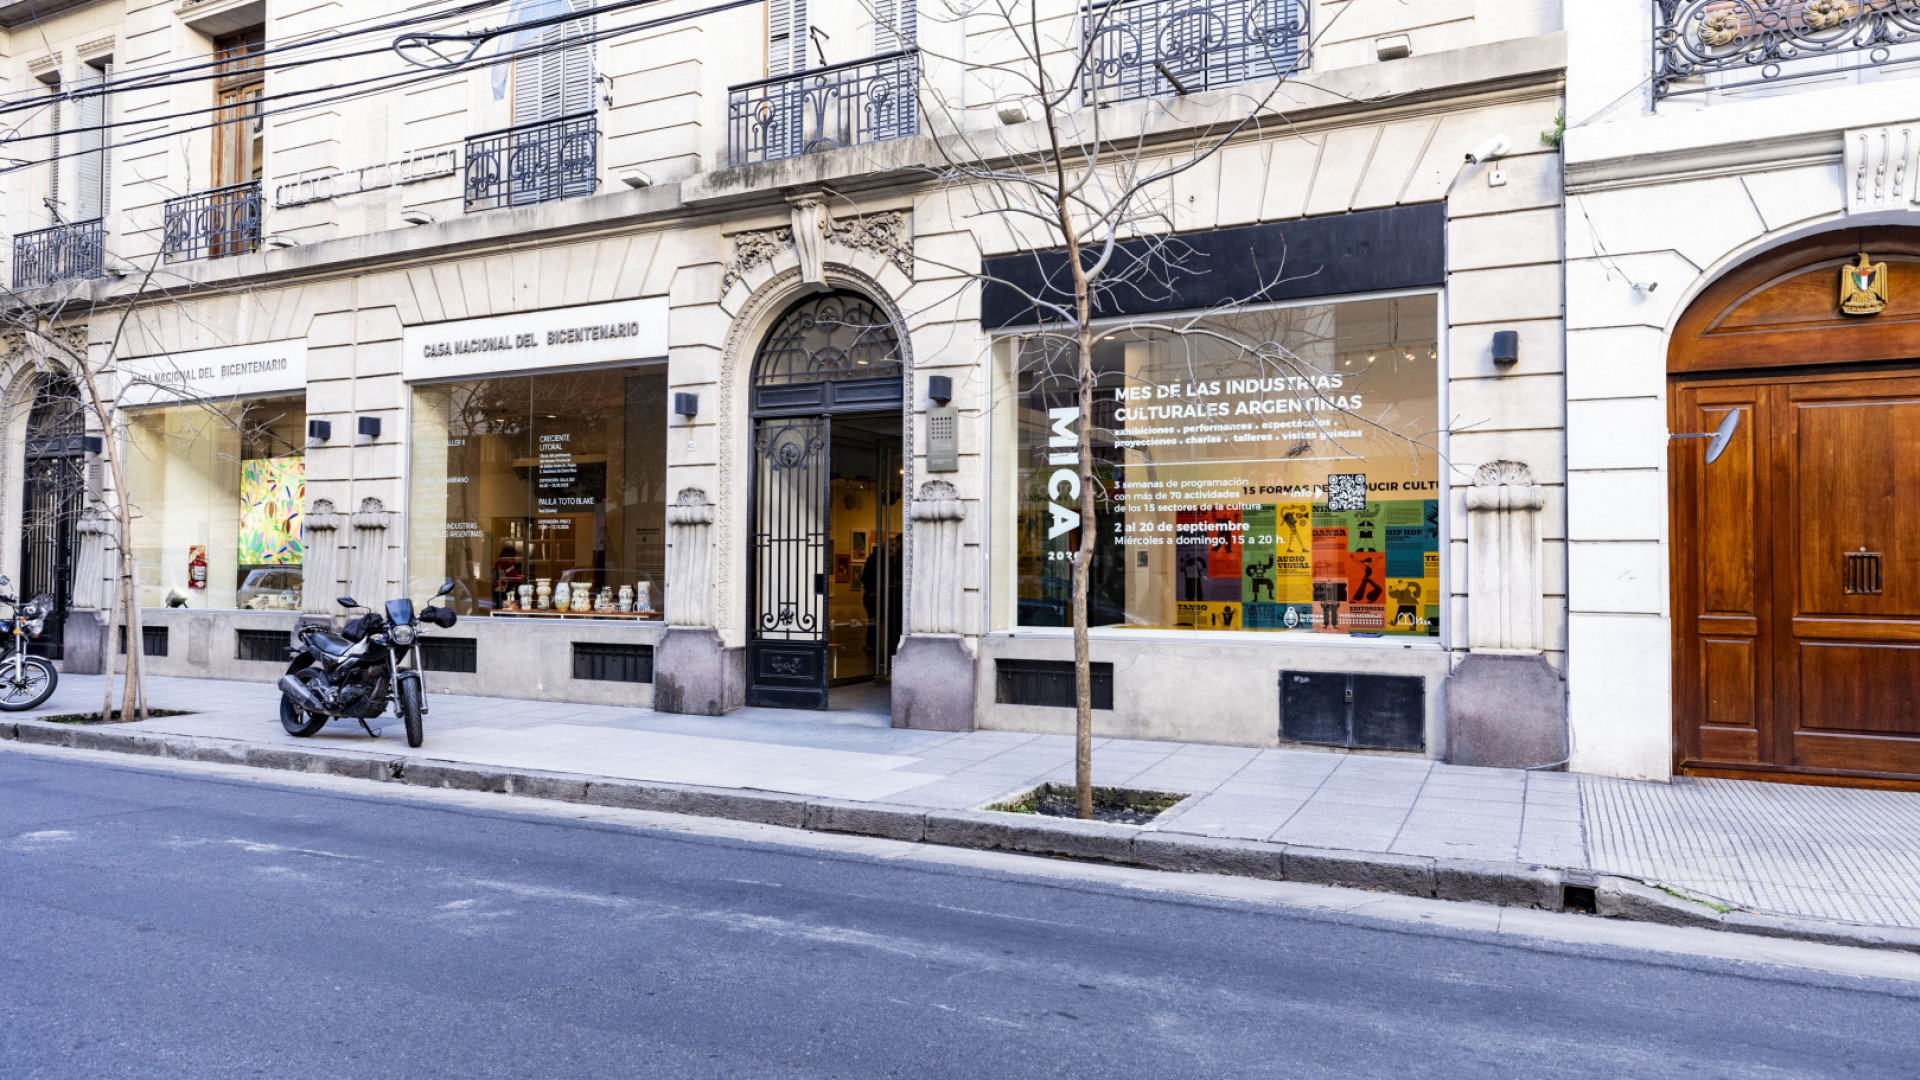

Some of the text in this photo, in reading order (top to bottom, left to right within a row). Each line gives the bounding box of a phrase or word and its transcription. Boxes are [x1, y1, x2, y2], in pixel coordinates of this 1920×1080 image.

[423, 321, 639, 358] CASA NACIONAL DEL BICENTENARIO
[154, 369, 196, 383] NACIONAL
[199, 367, 215, 379] DEL
[221, 357, 287, 377] BICENTENARIO
[1114, 374, 1343, 401] MES DE LAS INDUSTRIAS
[1114, 395, 1363, 422] CULTURALES ARGENTINAS
[1114, 426, 1175, 436] exhibiciones
[1183, 422, 1253, 435] performances
[539, 433, 571, 443] CRECIENTE
[1114, 437, 1176, 448] proyecciones
[1186, 435, 1222, 444] charlas
[1233, 433, 1272, 442] talleres
[1282, 431, 1317, 440] visitas
[539, 443, 562, 451] LITORAL
[1048, 406, 1081, 540] MICA
[1114, 477, 1249, 489] 3 semanas de programación
[1133, 491, 1153, 500] más
[1155, 491, 1168, 499] de
[1170, 491, 1182, 500] 70
[1184, 490, 1240, 500] actividades
[1243, 486, 1256, 495] 15
[1259, 484, 1309, 494] FORMAS
[1291, 488, 1313, 498] info
[558, 497, 575, 505] TOTO
[576, 496, 595, 505] BLAKE
[1114, 504, 1126, 512] de
[1128, 504, 1141, 512] los
[1144, 503, 1155, 512] 15
[1157, 503, 1198, 512] sectores
[1200, 502, 1212, 511] de
[1215, 502, 1224, 511] la
[1226, 502, 1261, 511] cultura
[1114, 522, 1122, 532] 2
[1125, 521, 1136, 532] al
[1139, 522, 1154, 532] 20
[1157, 521, 1173, 531] de
[1176, 520, 1250, 534] septiembre
[449, 530, 483, 538] ARGENTINAS
[1114, 534, 1286, 547] Miércoles a domingo, 15 a 20 h.
